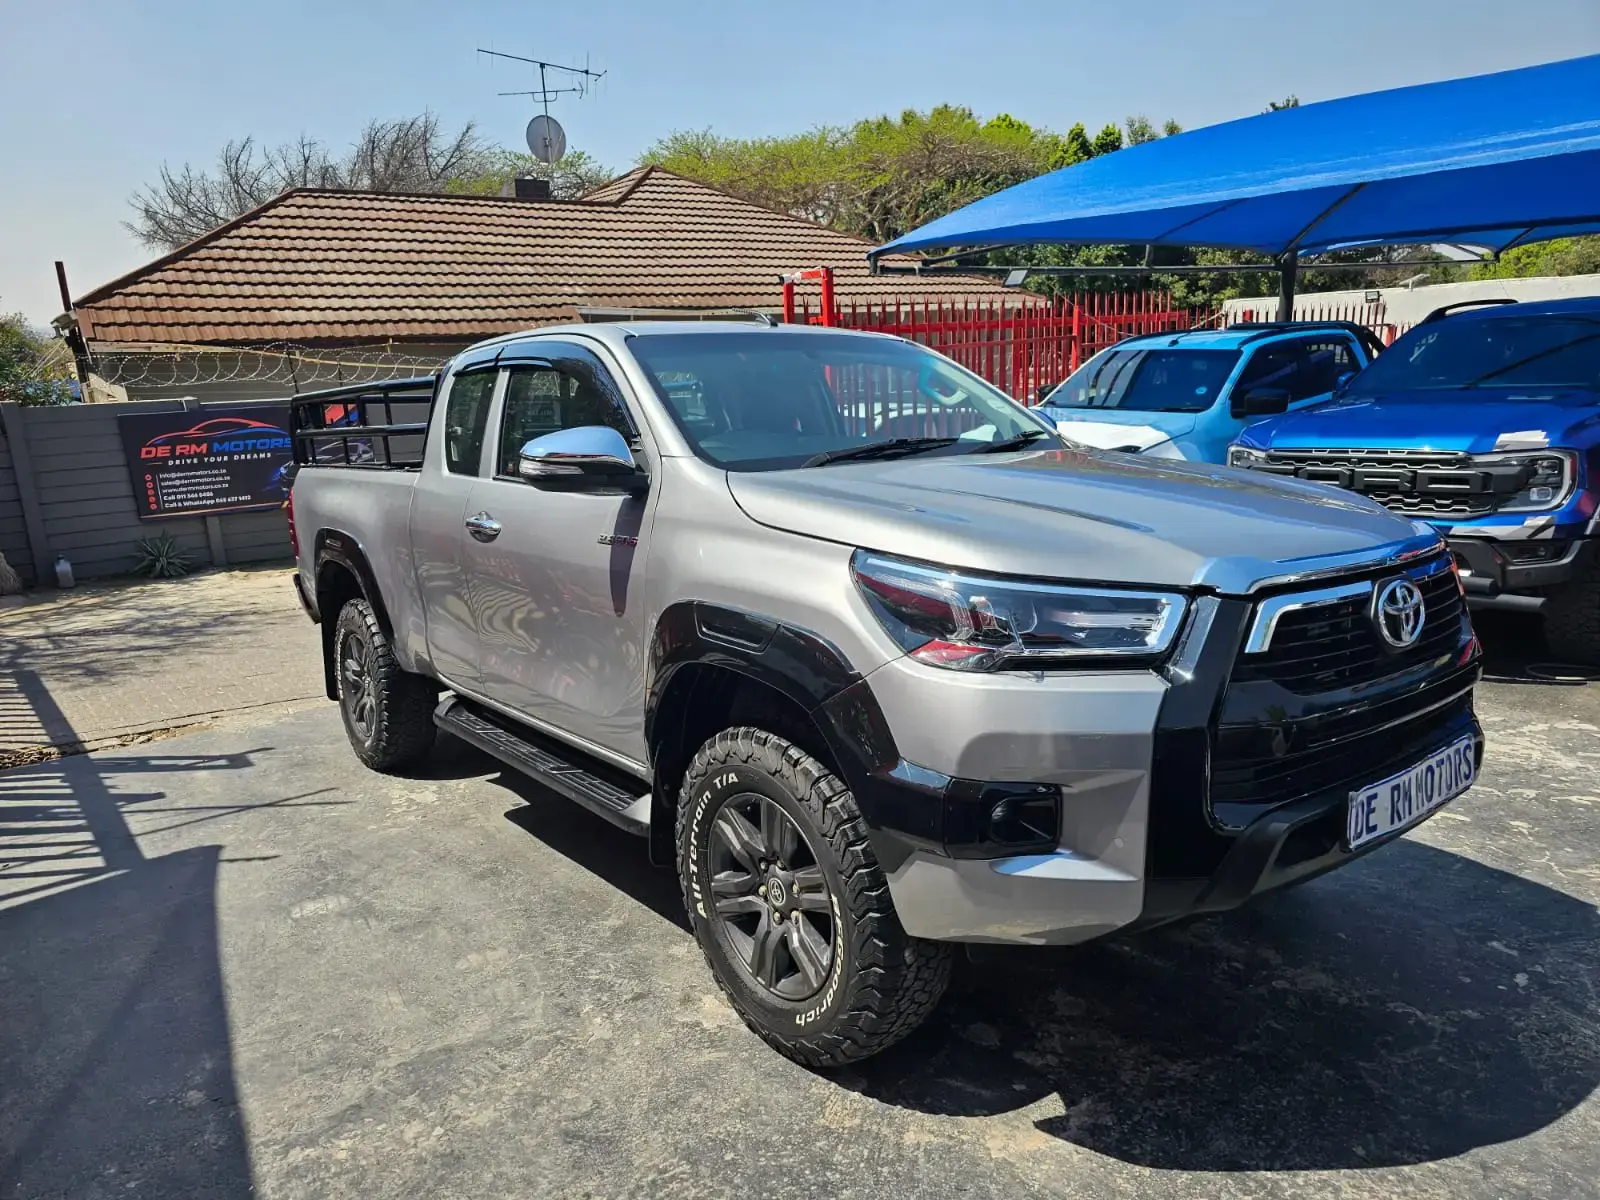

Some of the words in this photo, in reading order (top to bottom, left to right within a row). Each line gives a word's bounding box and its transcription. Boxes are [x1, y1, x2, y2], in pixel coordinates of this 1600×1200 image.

[141, 445, 171, 459] DE
[175, 443, 207, 456] RM
[212, 438, 292, 453] MOTORS
[168, 457, 198, 466] DRIVE
[204, 455, 228, 463] YOUR
[234, 452, 272, 461] DREAMS
[163, 493, 176, 501] Call
[183, 499, 215, 508] WhatsApp
[1352, 792, 1378, 842] DE
[1415, 743, 1473, 812] MOTORS
[689, 790, 712, 919] All-Terrain
[713, 772, 739, 790] T/A
